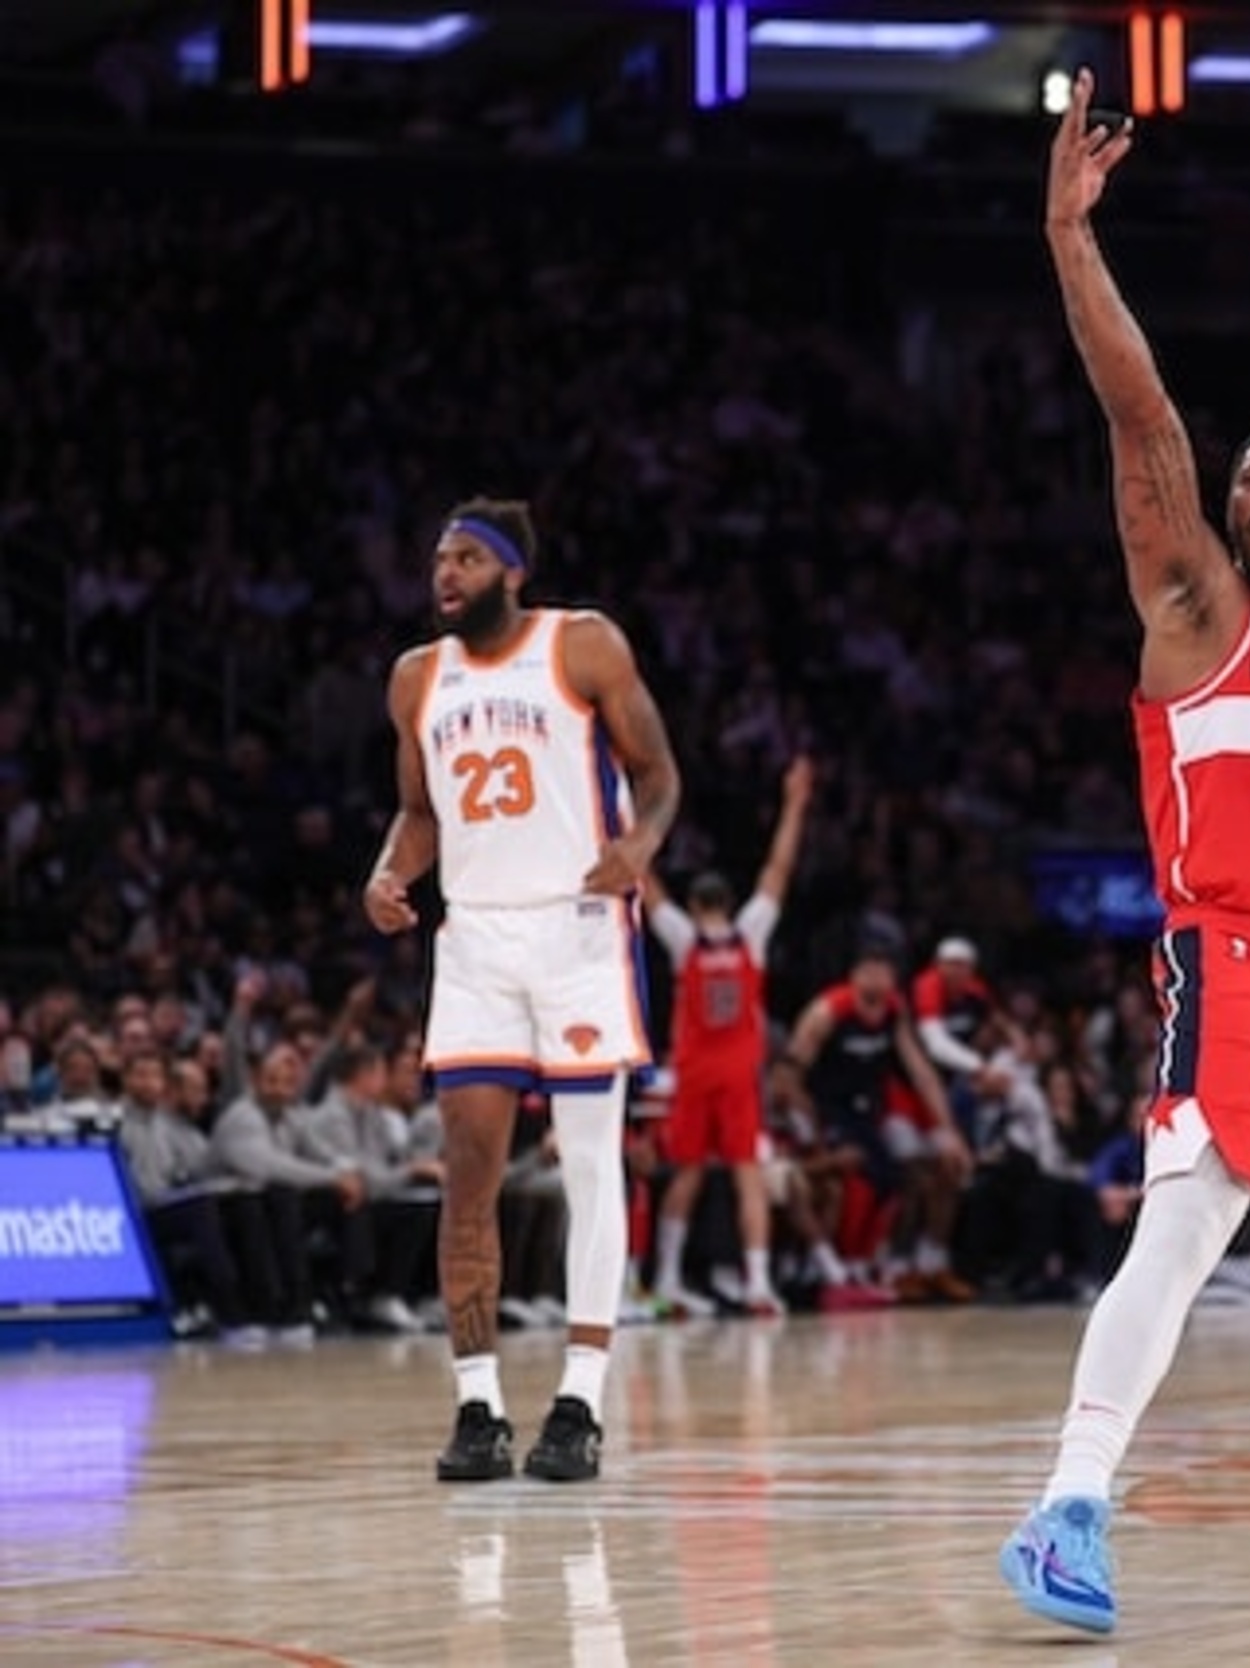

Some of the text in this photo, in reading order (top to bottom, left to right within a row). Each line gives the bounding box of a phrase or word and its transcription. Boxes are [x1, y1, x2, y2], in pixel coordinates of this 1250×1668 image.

[433, 697, 549, 756] NEW YORK
[452, 744, 535, 823] 23
[0, 1198, 125, 1257] master
